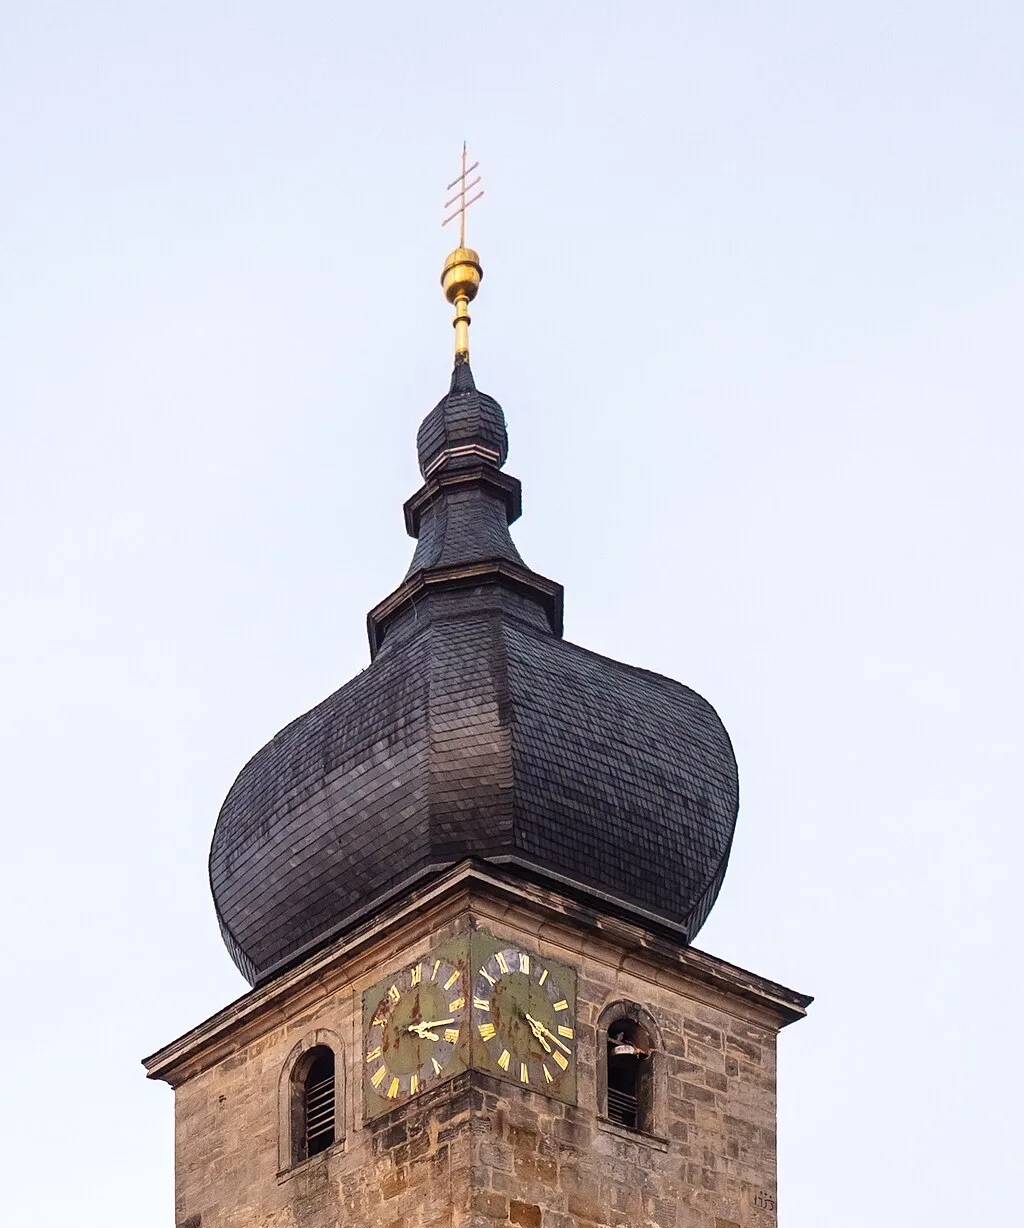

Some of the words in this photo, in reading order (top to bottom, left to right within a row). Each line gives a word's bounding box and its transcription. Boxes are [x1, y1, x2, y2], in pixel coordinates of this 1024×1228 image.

[431, 960, 441, 980] I
[495, 952, 509, 974] XI
[519, 953, 530, 975] XII
[411, 962, 422, 988] XII
[443, 970, 460, 990] II
[479, 966, 496, 986] X
[538, 969, 548, 986] I
[553, 999, 569, 1012] II
[557, 1025, 573, 1039] III
[432, 1057, 443, 1075] V
[520, 1062, 529, 1084] VI
[542, 1063, 553, 1084] V
